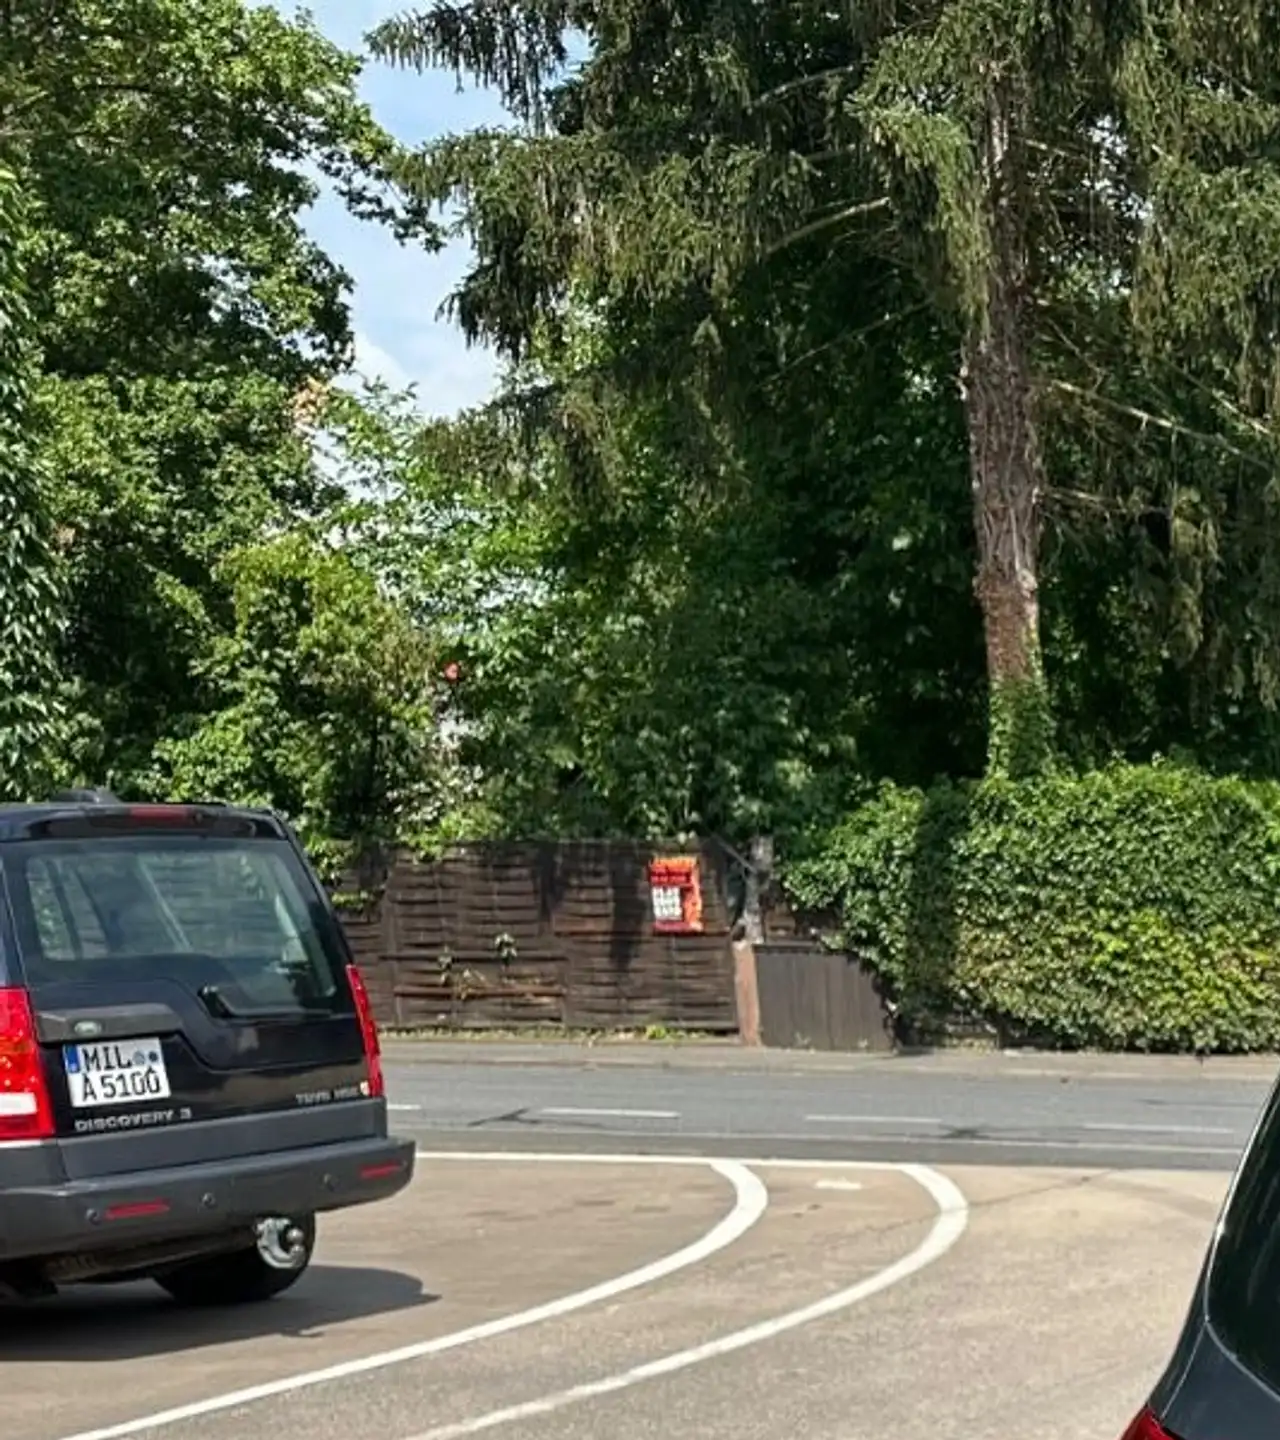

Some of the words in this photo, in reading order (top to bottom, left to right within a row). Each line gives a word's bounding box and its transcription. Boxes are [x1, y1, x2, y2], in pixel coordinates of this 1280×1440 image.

[81, 1045, 132, 1072] MIL
[82, 1072, 98, 1102] A
[100, 1068, 161, 1099] 5100
[75, 1109, 174, 1132] DISCOVERY
